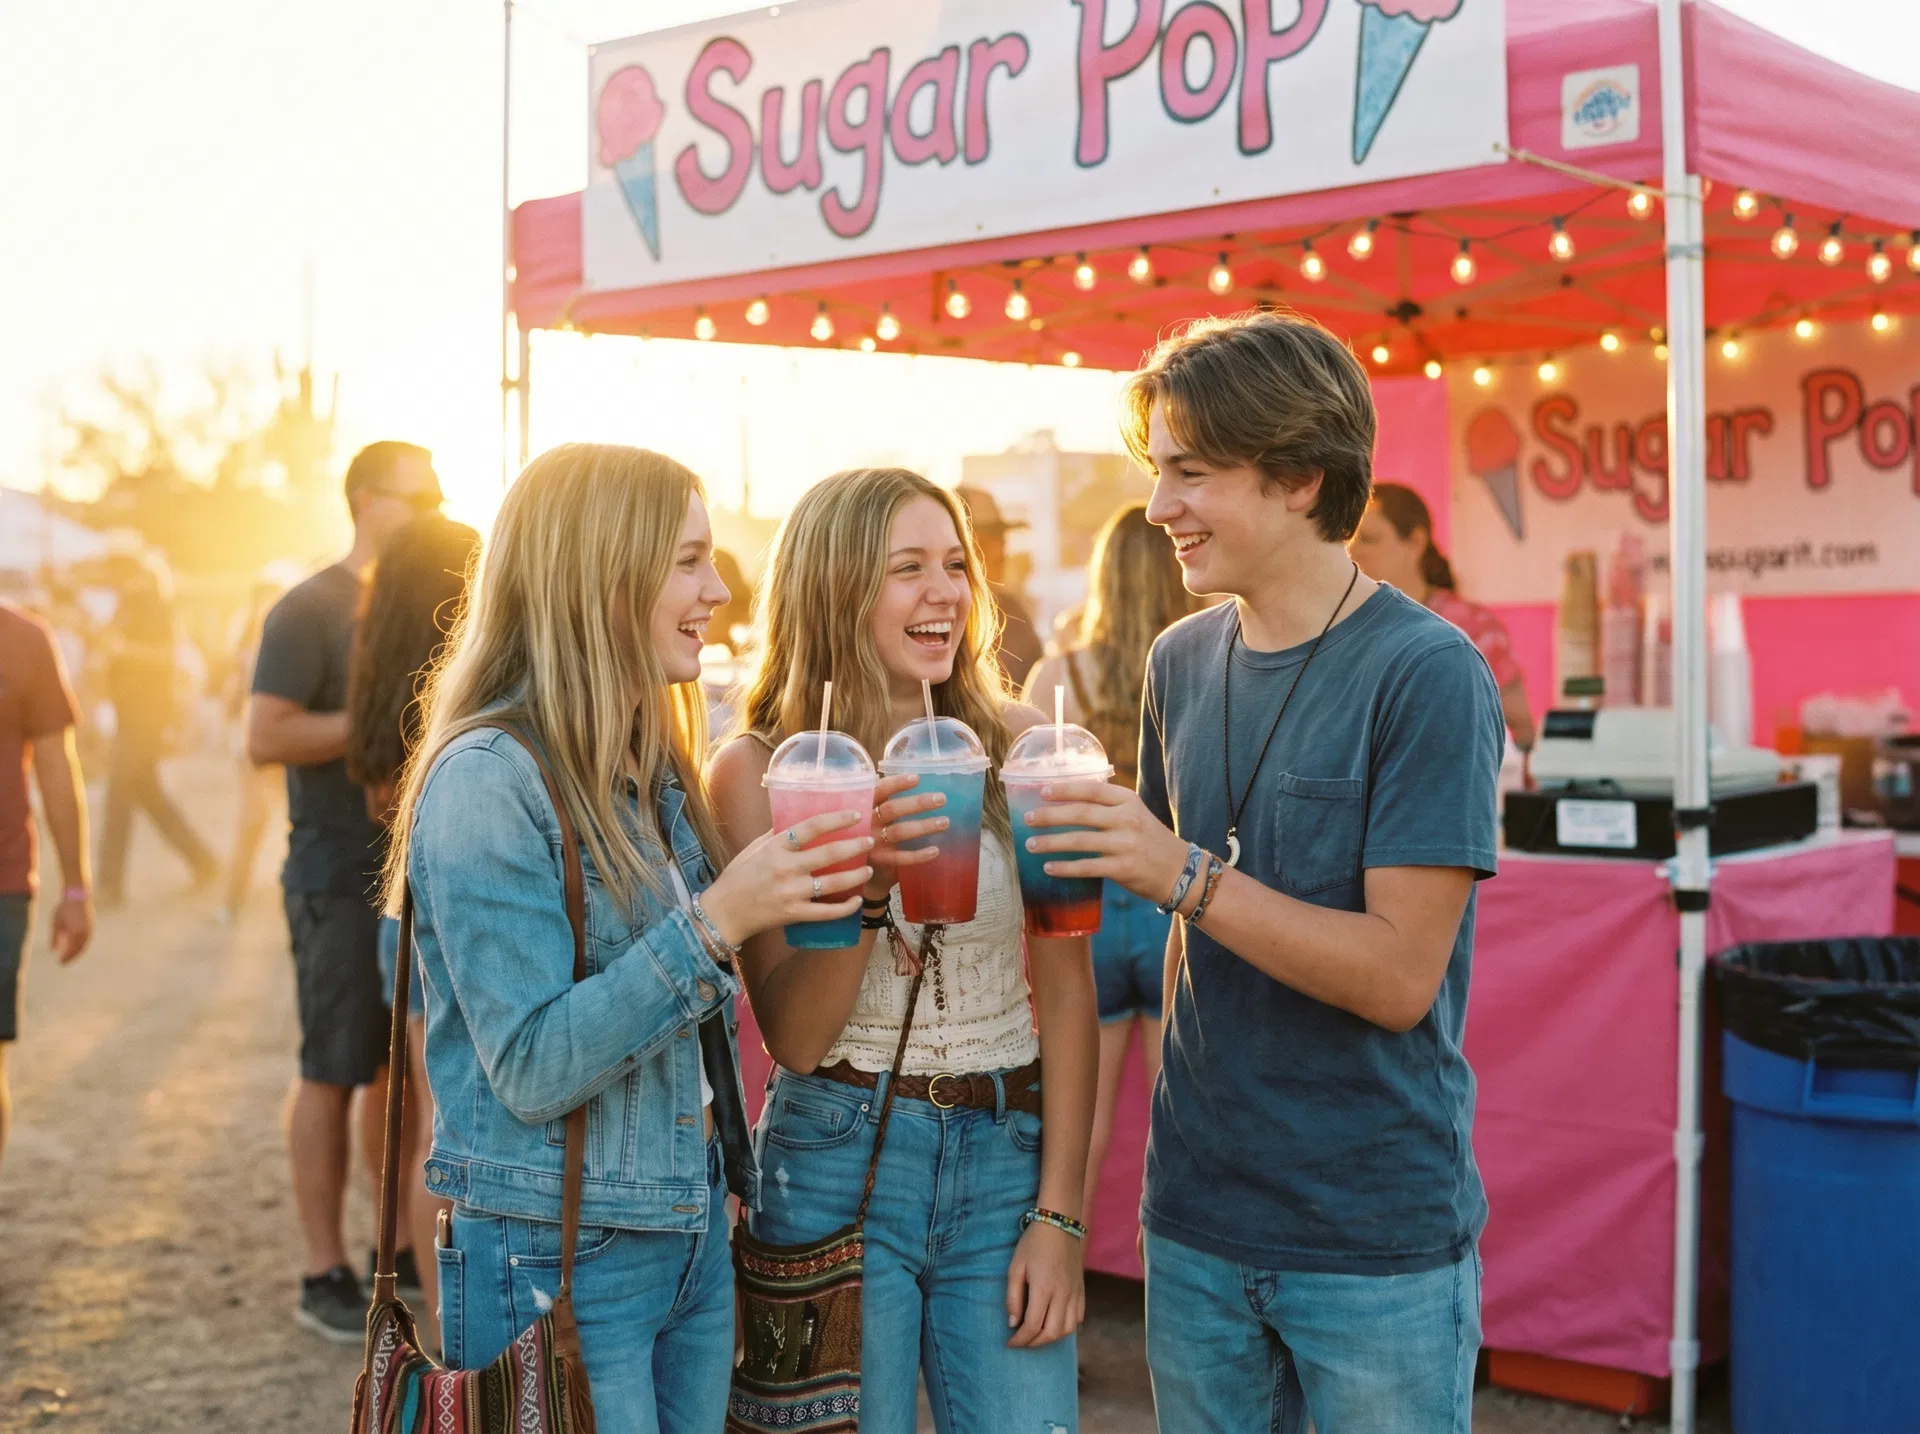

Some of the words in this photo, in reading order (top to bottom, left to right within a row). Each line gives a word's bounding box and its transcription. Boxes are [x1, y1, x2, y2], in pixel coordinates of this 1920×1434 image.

[674, 35, 1030, 239] Sugar
[1071, 0, 1330, 168] Pop
[1799, 366, 1920, 499] Po
